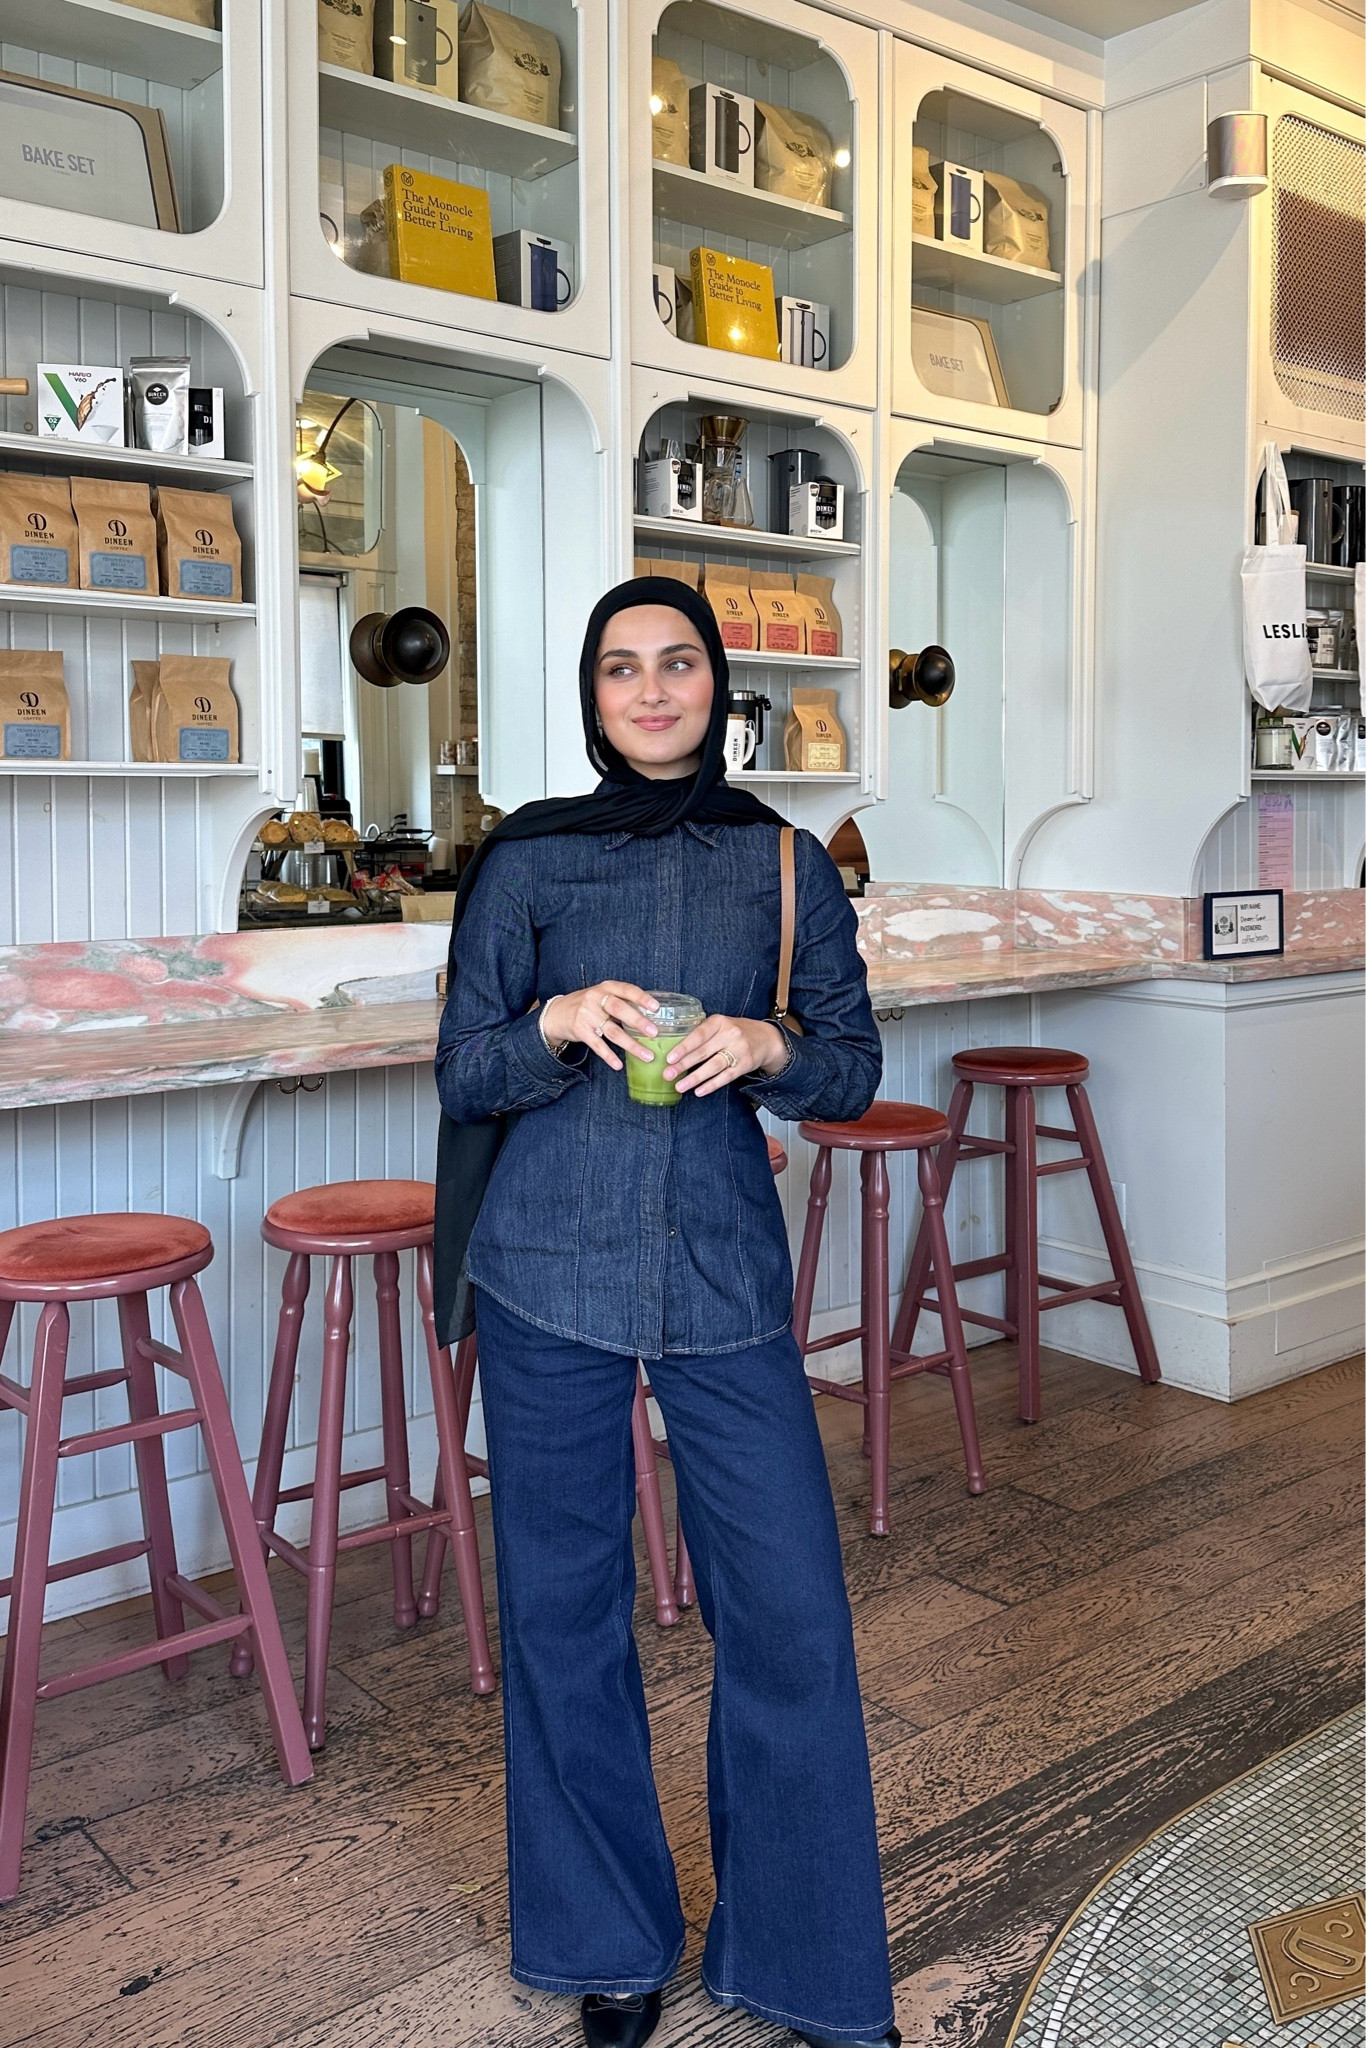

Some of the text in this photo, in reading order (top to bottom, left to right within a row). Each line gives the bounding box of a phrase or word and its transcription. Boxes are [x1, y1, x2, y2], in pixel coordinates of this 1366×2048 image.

[22, 144, 95, 176] BAKE SET
[402, 188, 473, 217] The Monocle
[403, 201, 450, 222] Guide to
[403, 211, 474, 241] Better Living
[706, 268, 761, 292] The Monocle
[708, 278, 744, 296] Guide to
[709, 288, 762, 312] Better Living
[929, 352, 965, 372] BAKE SET
[24, 530, 55, 539] DINEEN
[104, 537, 133, 546] DINEEN
[192, 546, 220, 555] DINEEN
[1262, 623, 1308, 639] LESLI
[17, 708, 47, 716] DINEEN
